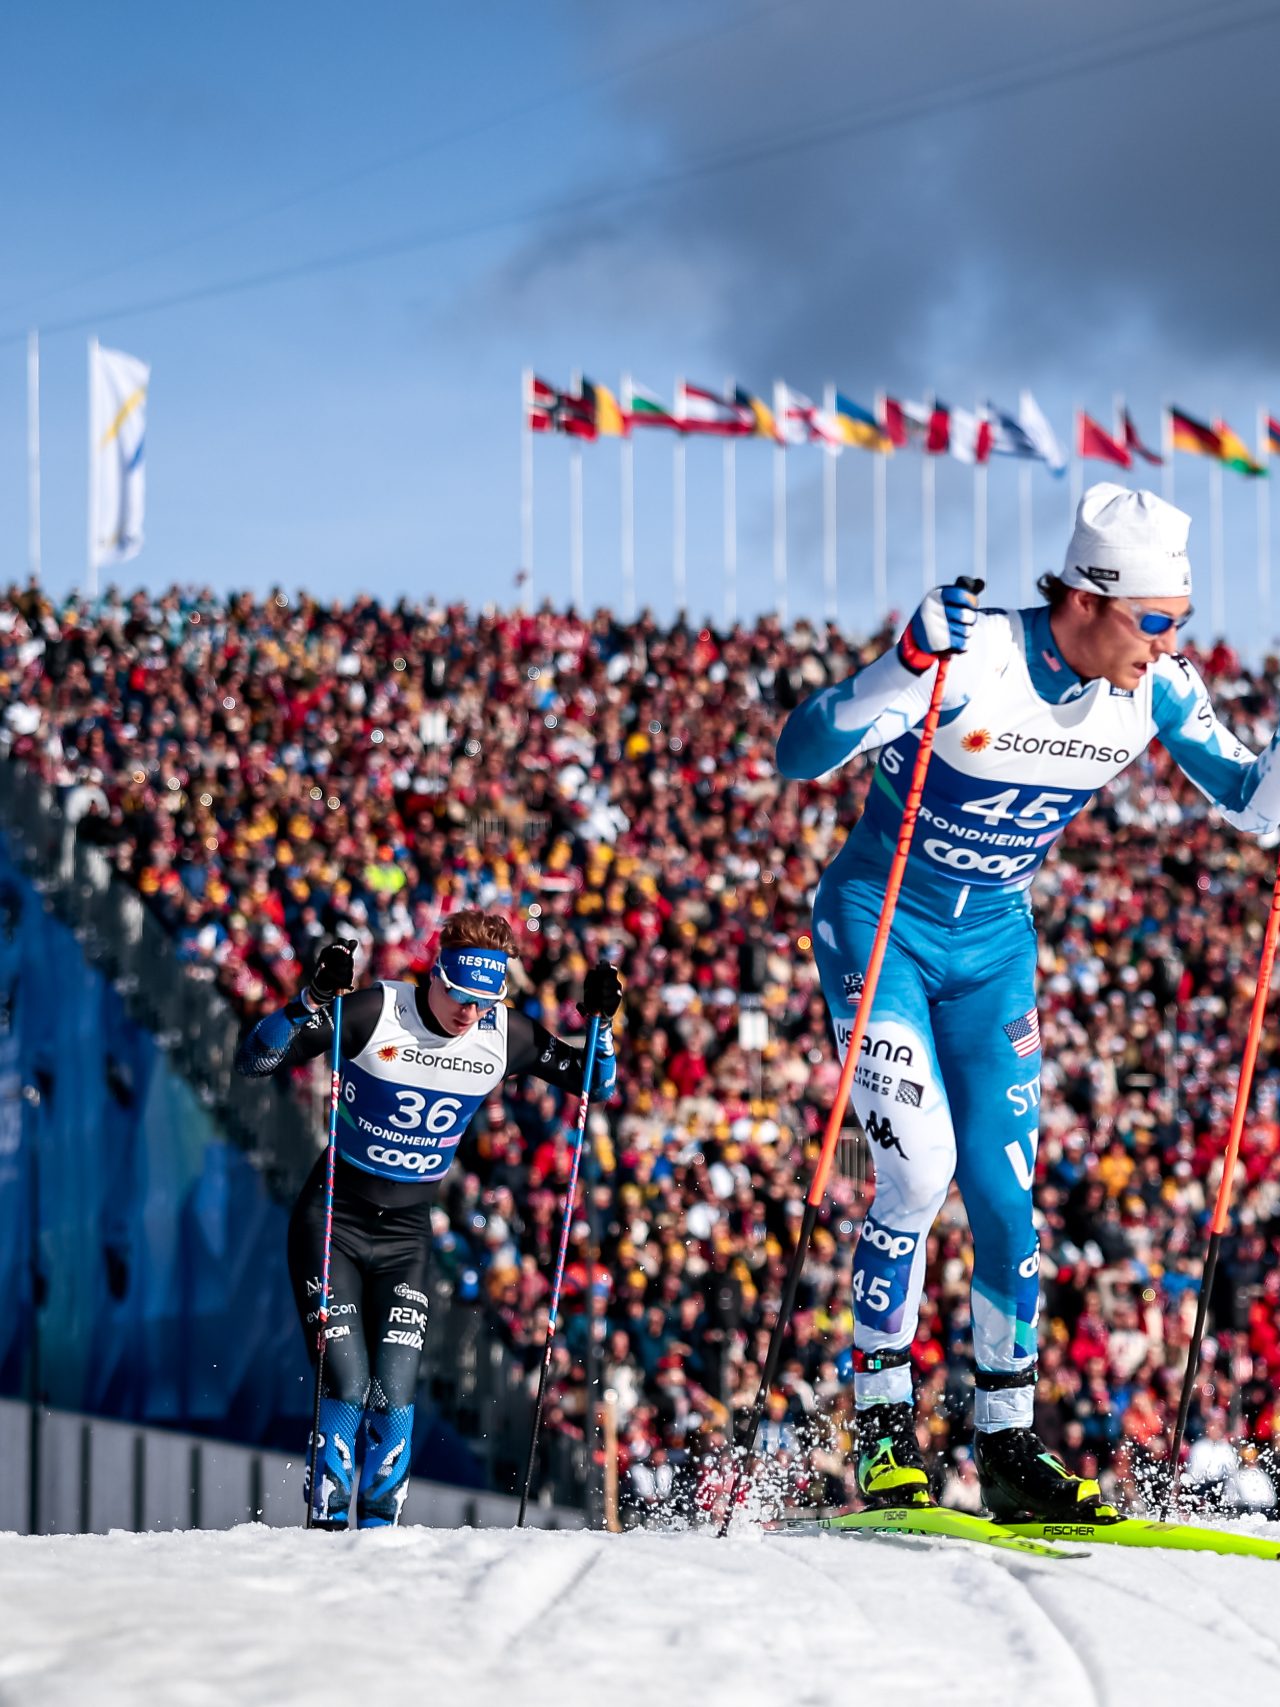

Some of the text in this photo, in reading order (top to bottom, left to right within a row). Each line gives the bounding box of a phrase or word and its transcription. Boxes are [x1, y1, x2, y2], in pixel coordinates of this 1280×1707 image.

[994, 732, 1130, 764] StoraEnso
[918, 803, 1035, 848] RONDHEIM
[961, 788, 1073, 829] 45
[923, 838, 1036, 878] coop
[401, 1049, 495, 1075] StoraEnso
[358, 1116, 438, 1147] TRONDHEIM
[388, 1090, 463, 1134] 36
[367, 1144, 443, 1174] coop
[861, 1215, 915, 1259] oop
[853, 1269, 891, 1312] 45
[1043, 1525, 1095, 1536] FISCHER
